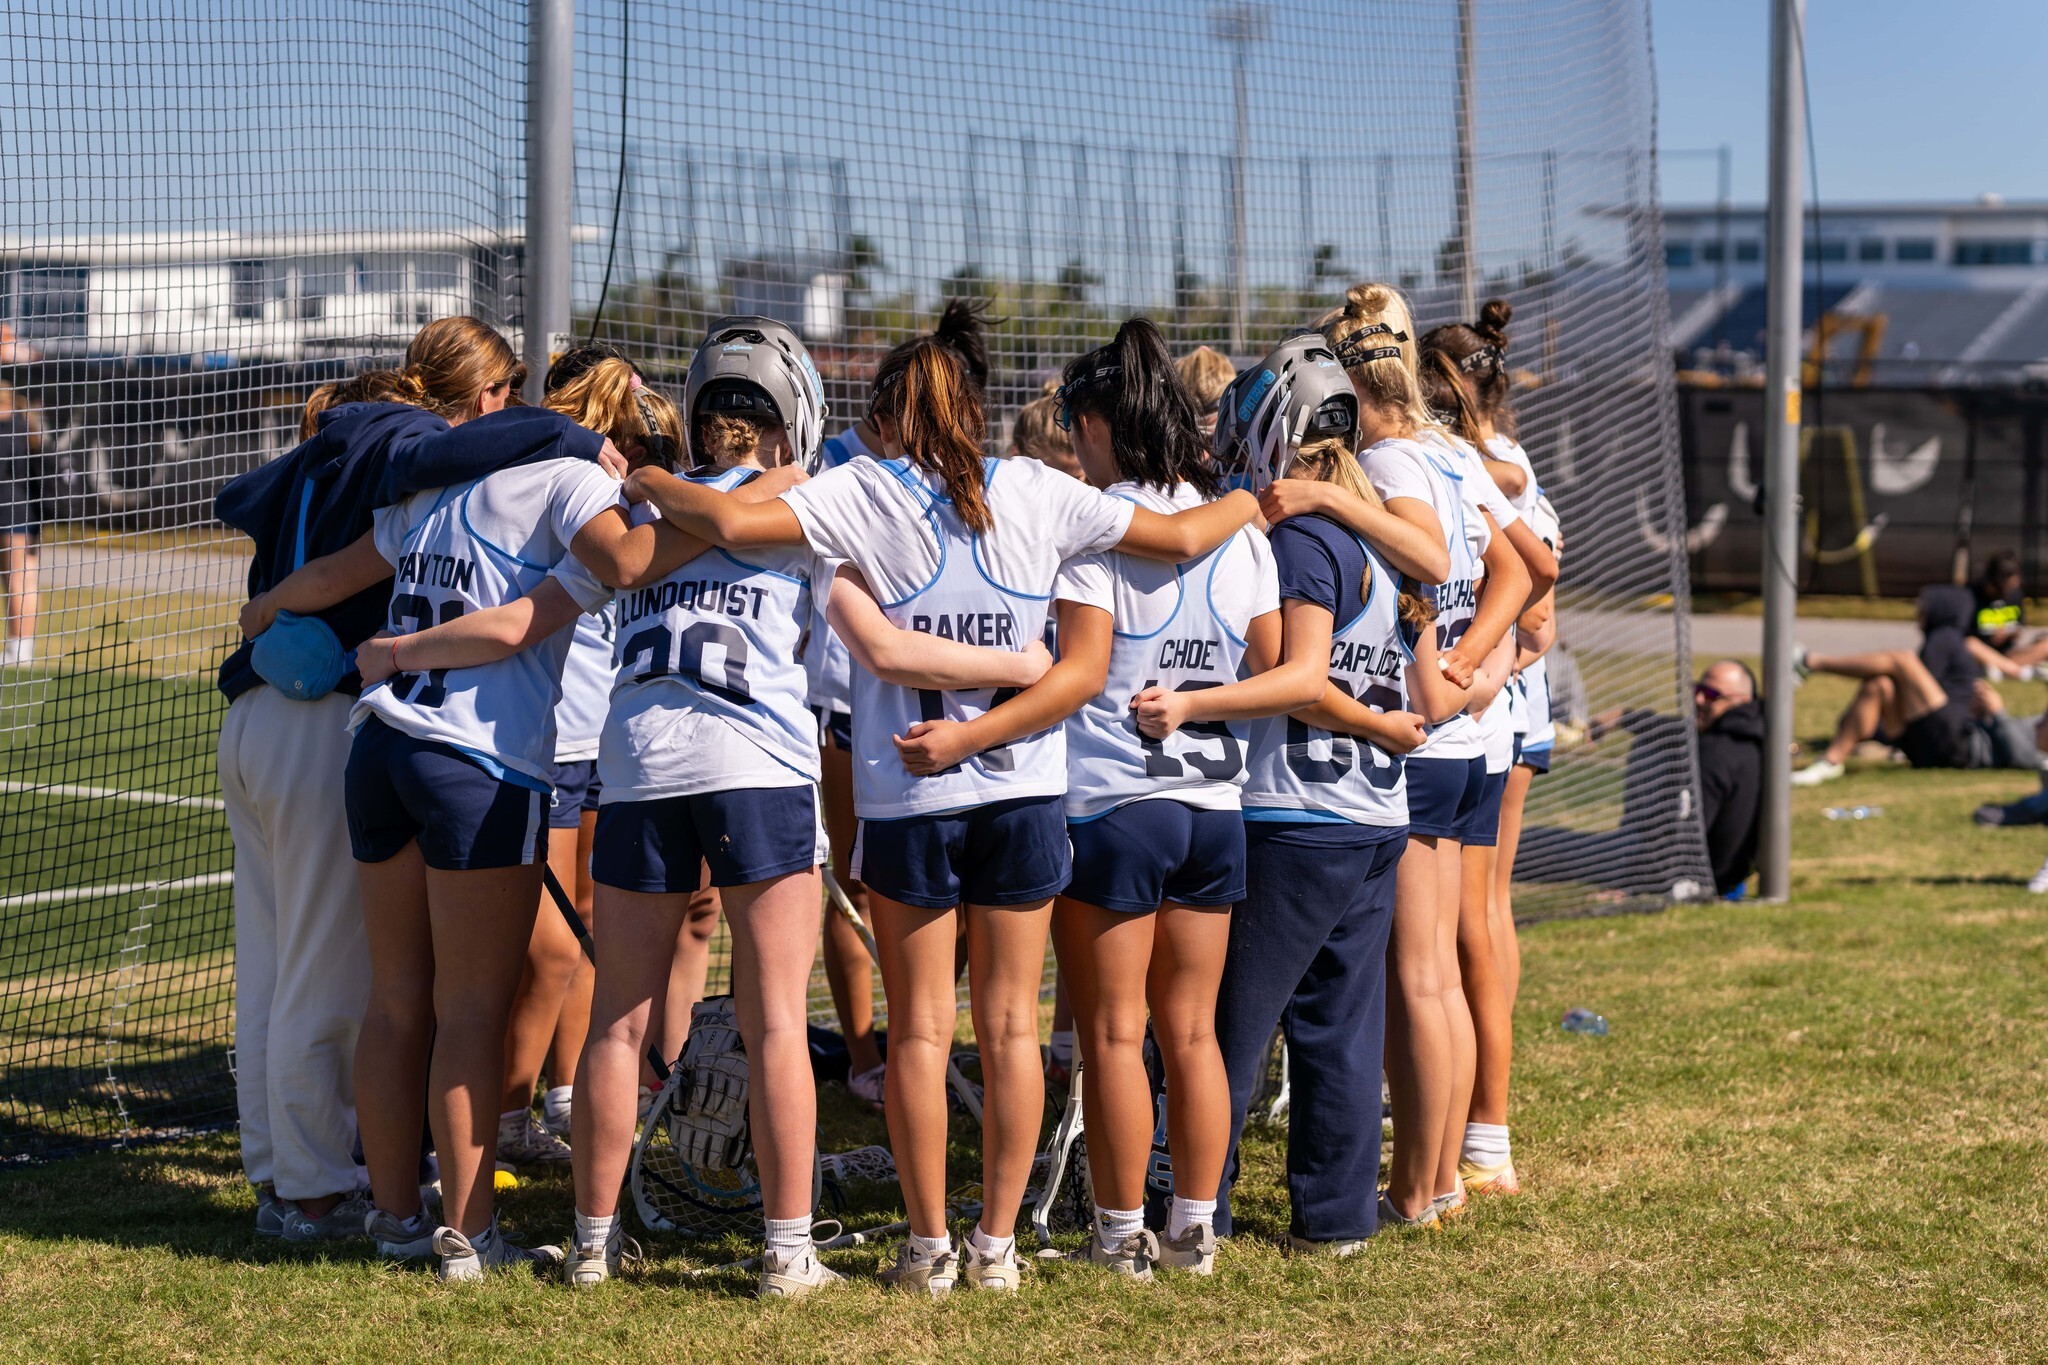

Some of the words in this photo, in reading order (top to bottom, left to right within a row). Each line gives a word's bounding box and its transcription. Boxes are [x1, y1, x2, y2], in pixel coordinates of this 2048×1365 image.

[1361, 325, 1385, 337] STX
[1374, 347, 1399, 359] STX
[1461, 349, 1487, 368] STX
[1065, 374, 1087, 396] STX
[1238, 369, 1276, 422] STEPS
[1440, 414, 1457, 424] ST
[621, 579, 769, 629] LUNDQUIST
[912, 612, 1013, 647] BAKER
[1159, 639, 1219, 671] CHOE
[1329, 641, 1403, 682] CAPLICE
